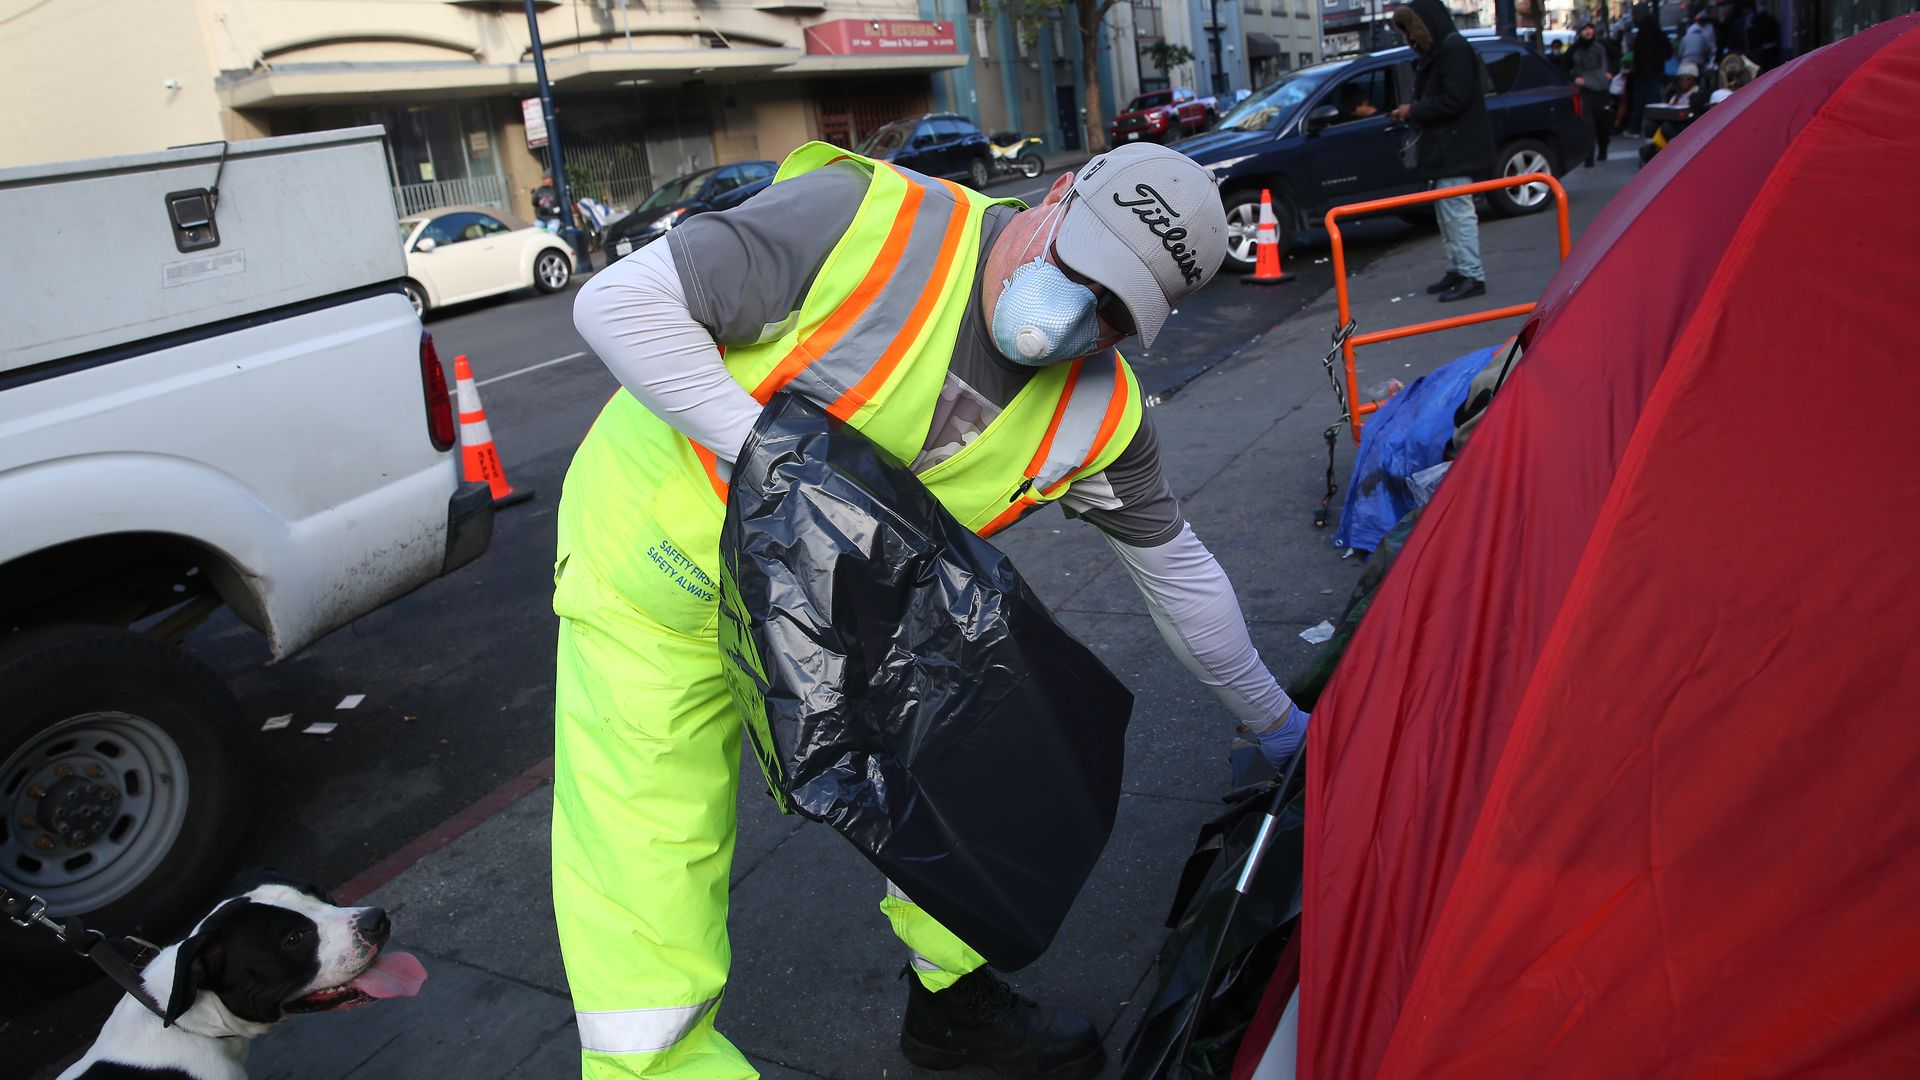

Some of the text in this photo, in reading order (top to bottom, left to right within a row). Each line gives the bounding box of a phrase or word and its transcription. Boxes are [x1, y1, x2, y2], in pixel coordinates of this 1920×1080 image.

[1113, 183, 1203, 285] Titleist
[647, 546, 714, 602] SAFETY ALWAYS
[659, 540, 693, 571] SAFETY
